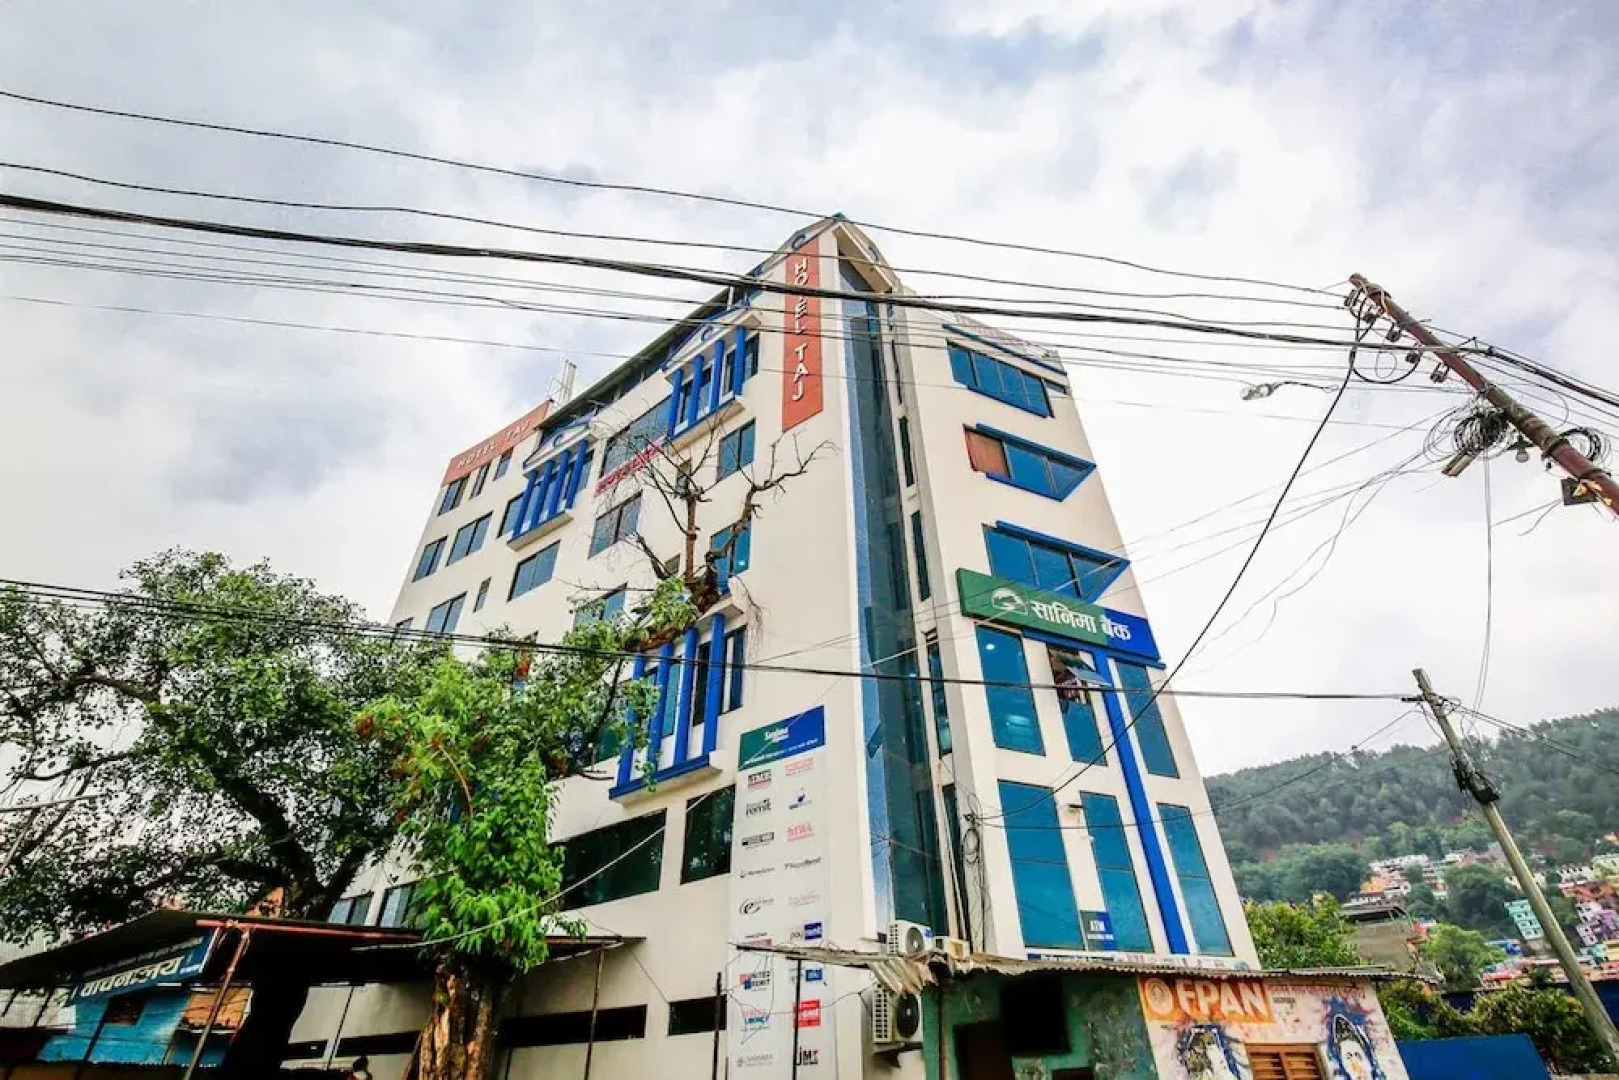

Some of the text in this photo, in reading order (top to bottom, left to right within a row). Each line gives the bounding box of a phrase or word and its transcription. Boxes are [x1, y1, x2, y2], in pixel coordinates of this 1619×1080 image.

[792, 257, 810, 401] HOEL TAJ
[1030, 600, 1097, 633] सानिमा
[1175, 977, 1268, 1022] FPAN
